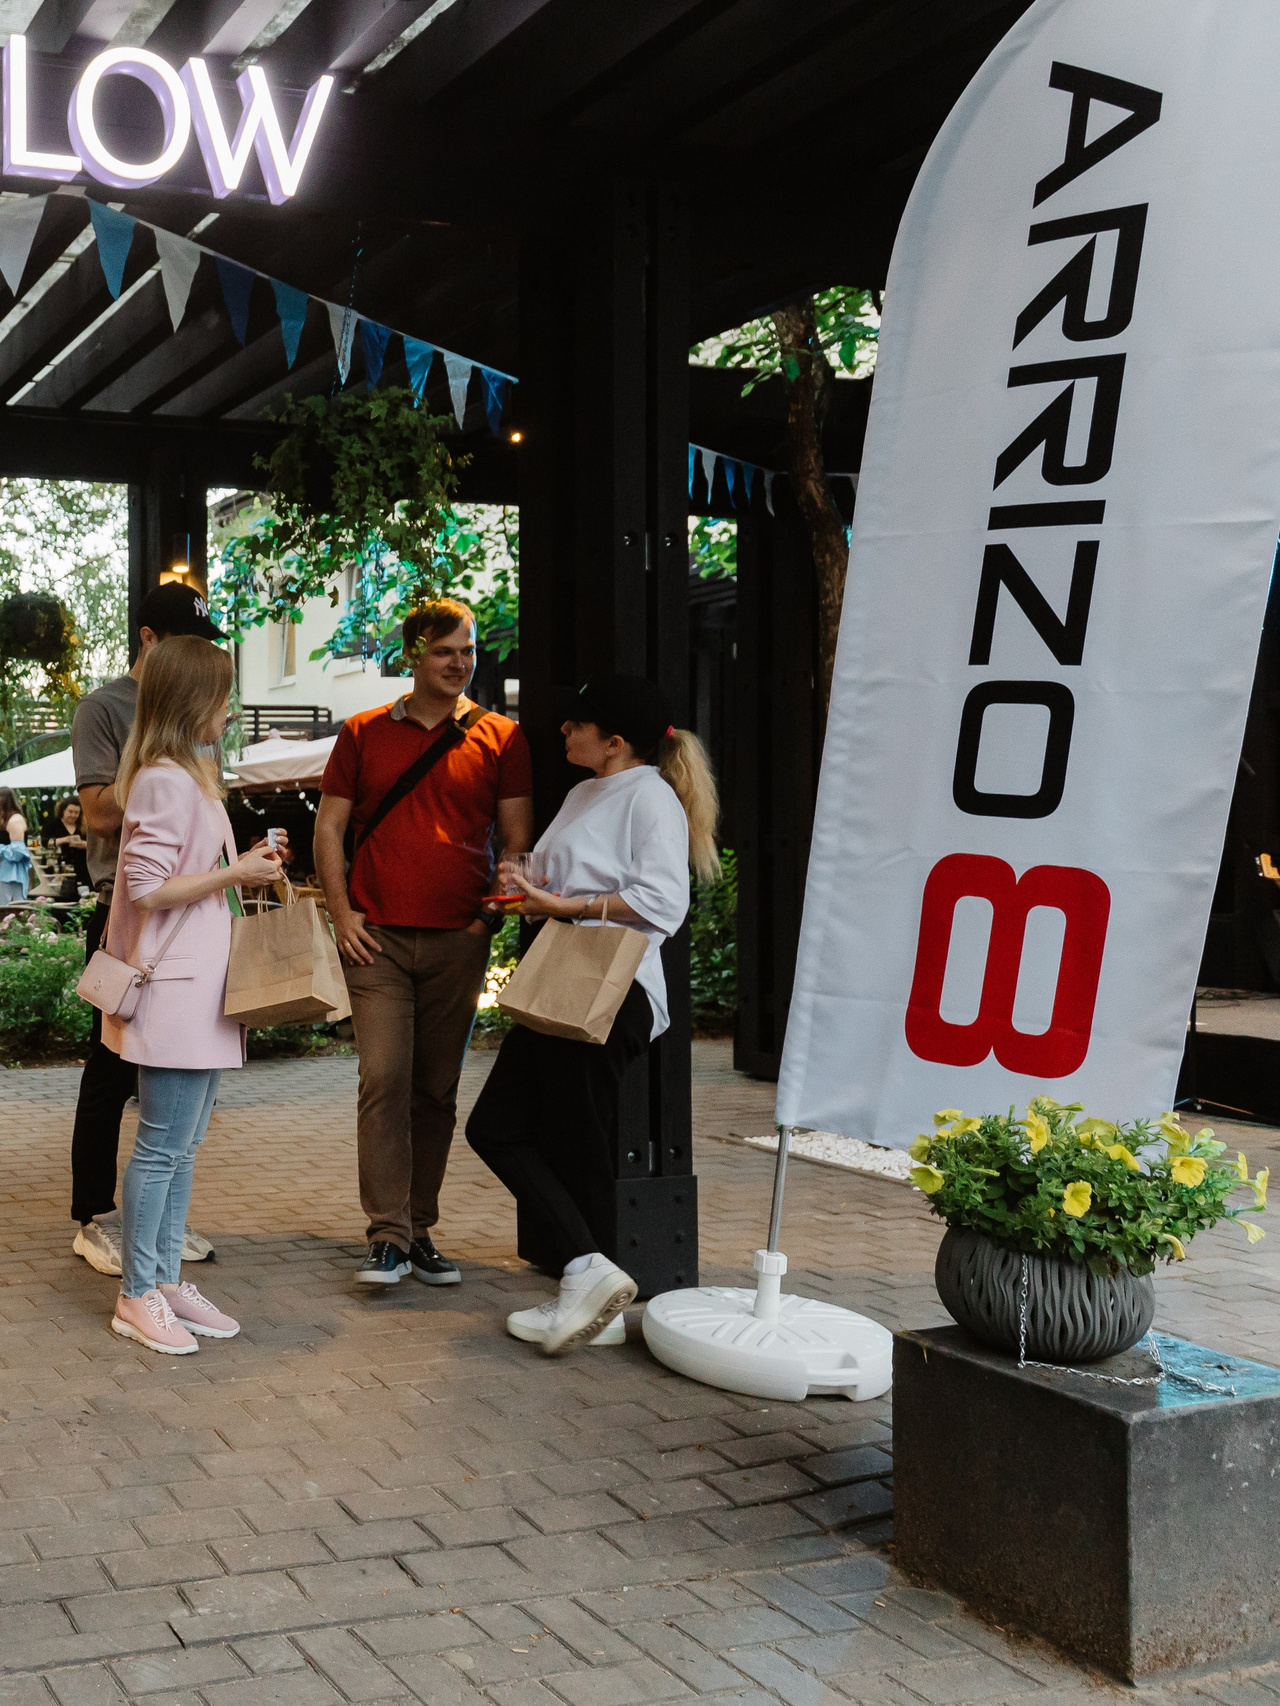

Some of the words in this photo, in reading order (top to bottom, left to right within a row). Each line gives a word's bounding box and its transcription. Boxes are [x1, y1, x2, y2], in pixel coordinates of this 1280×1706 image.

[952, 60, 1163, 820] ARRIZO
[193, 596, 209, 617] NY
[905, 853, 1111, 1079] 8
